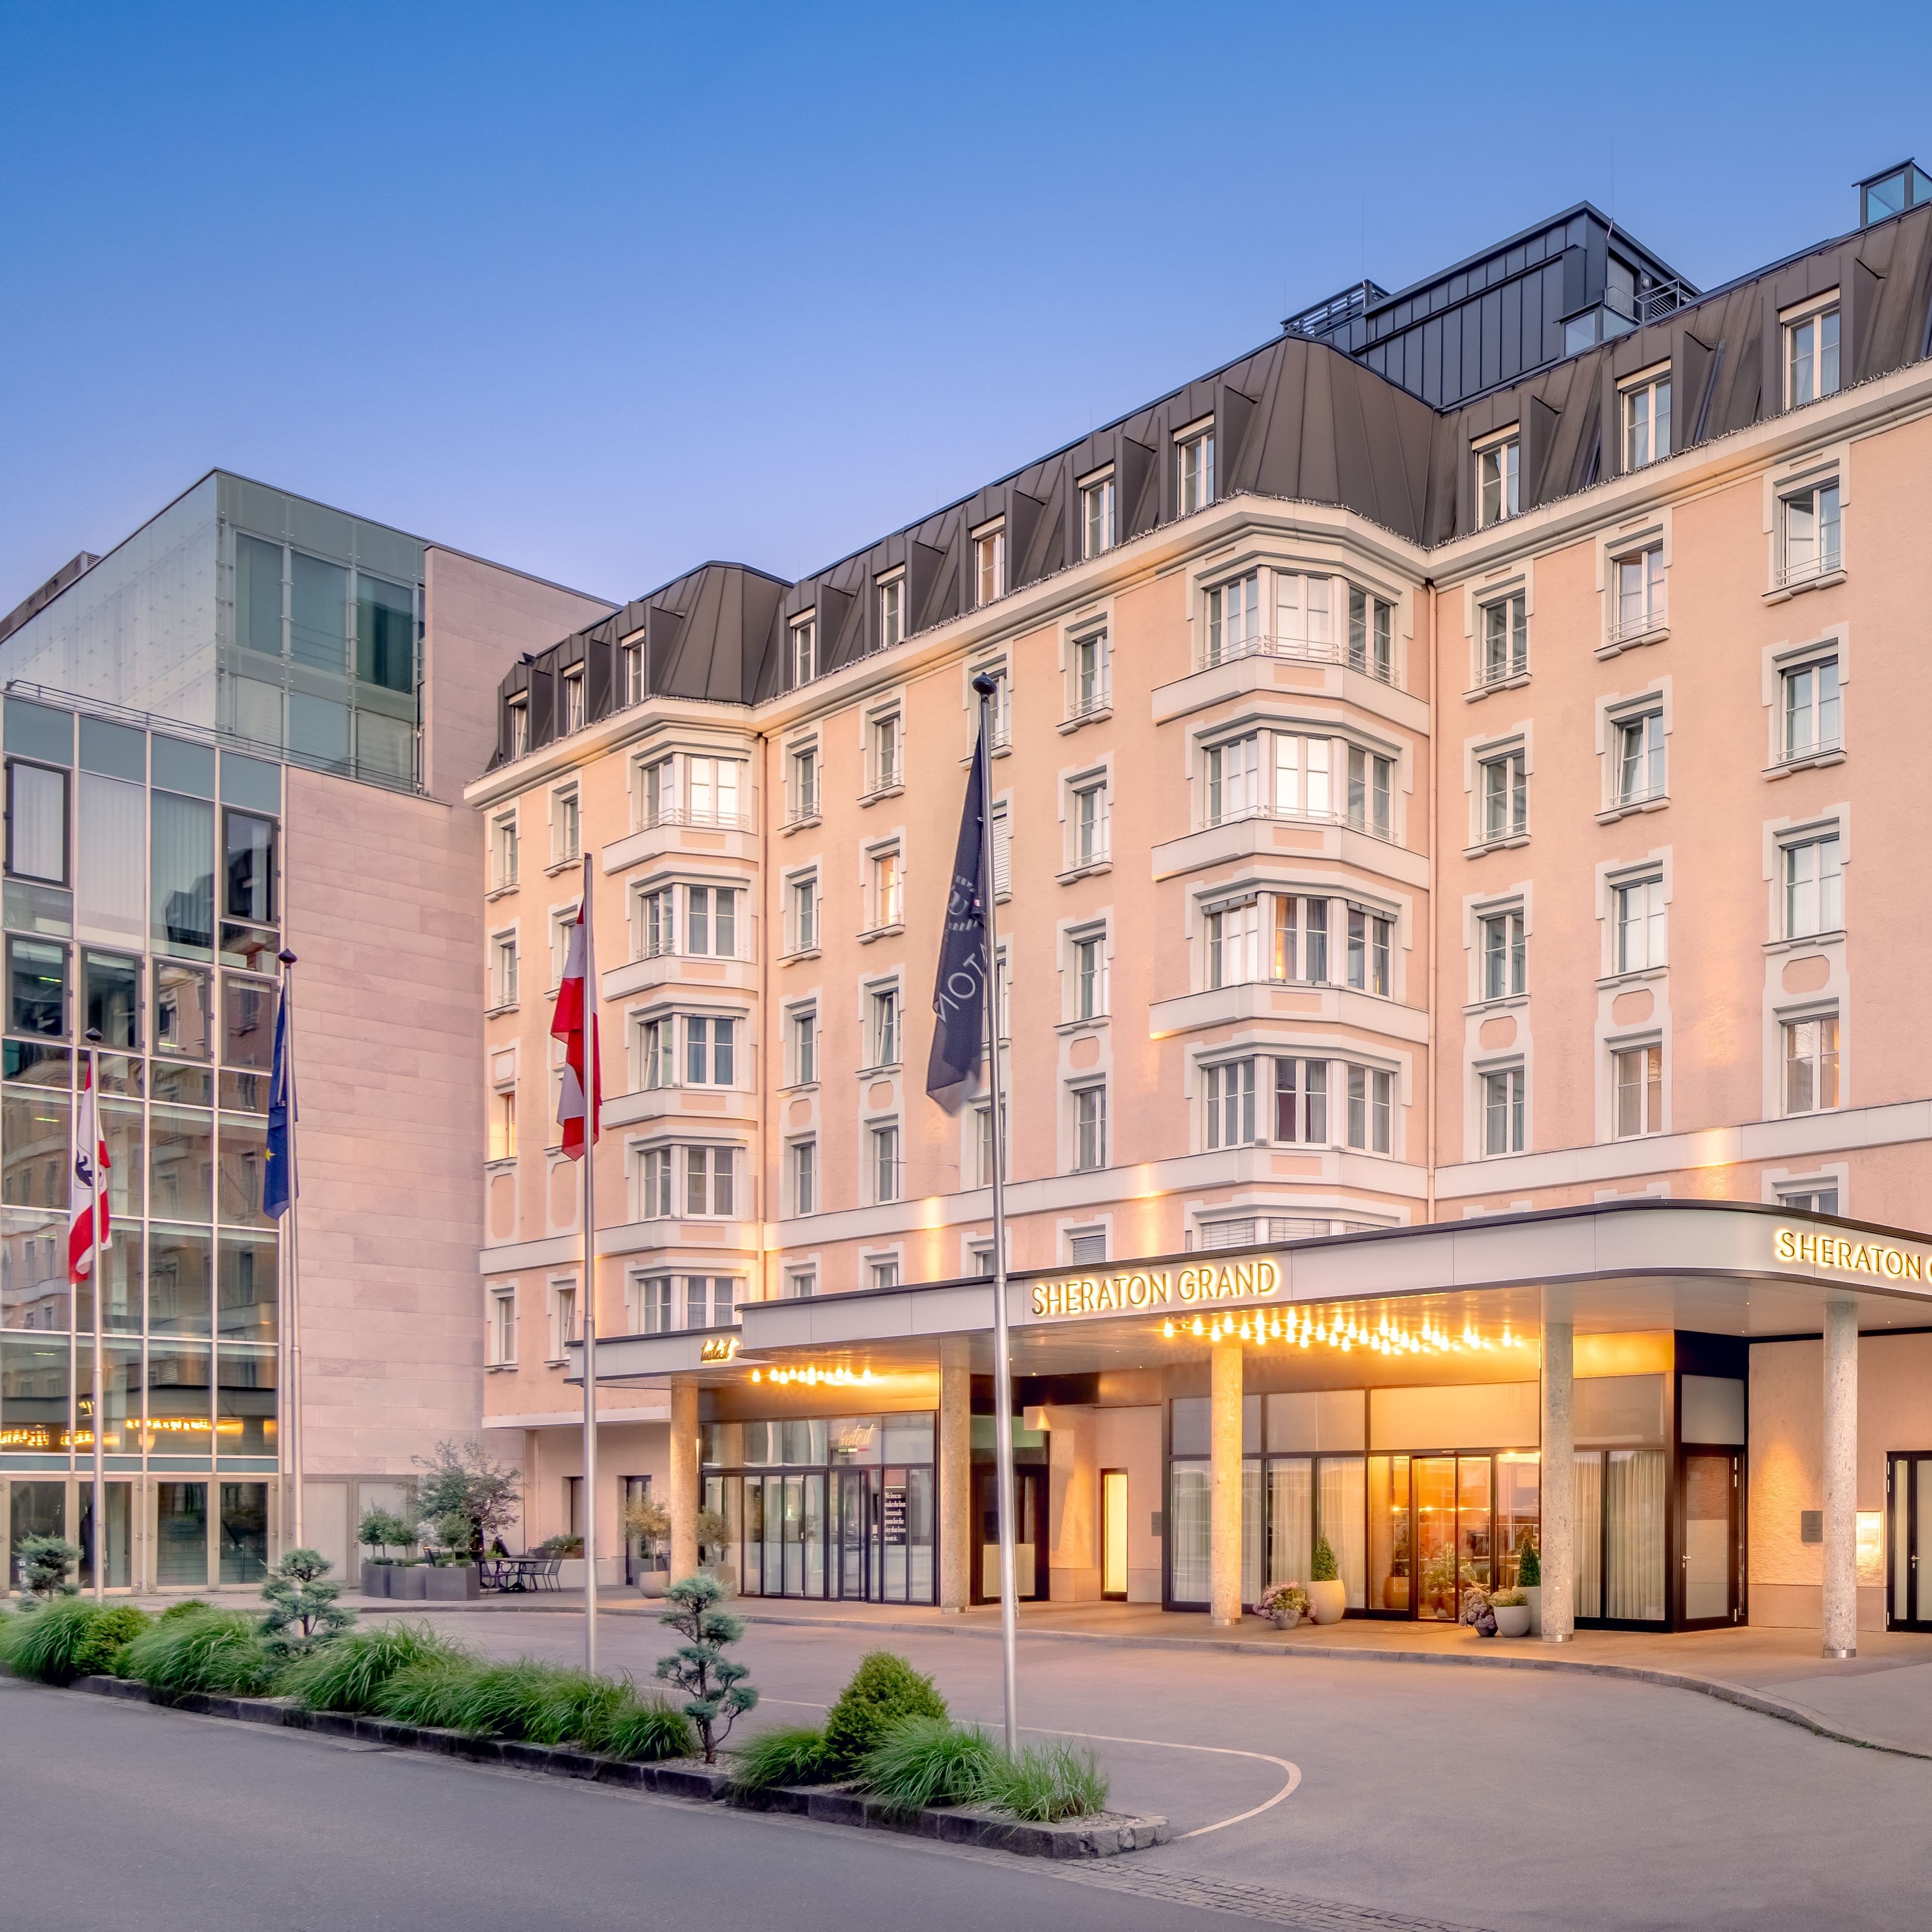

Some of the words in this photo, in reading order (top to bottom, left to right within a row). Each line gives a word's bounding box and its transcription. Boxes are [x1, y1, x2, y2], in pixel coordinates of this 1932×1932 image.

[1779, 1232, 1921, 1279] SHERATON
[1031, 1273, 1168, 1315] SHERATON
[1177, 1262, 1276, 1300] GRAND
[839, 1423, 879, 1445] taste.it
